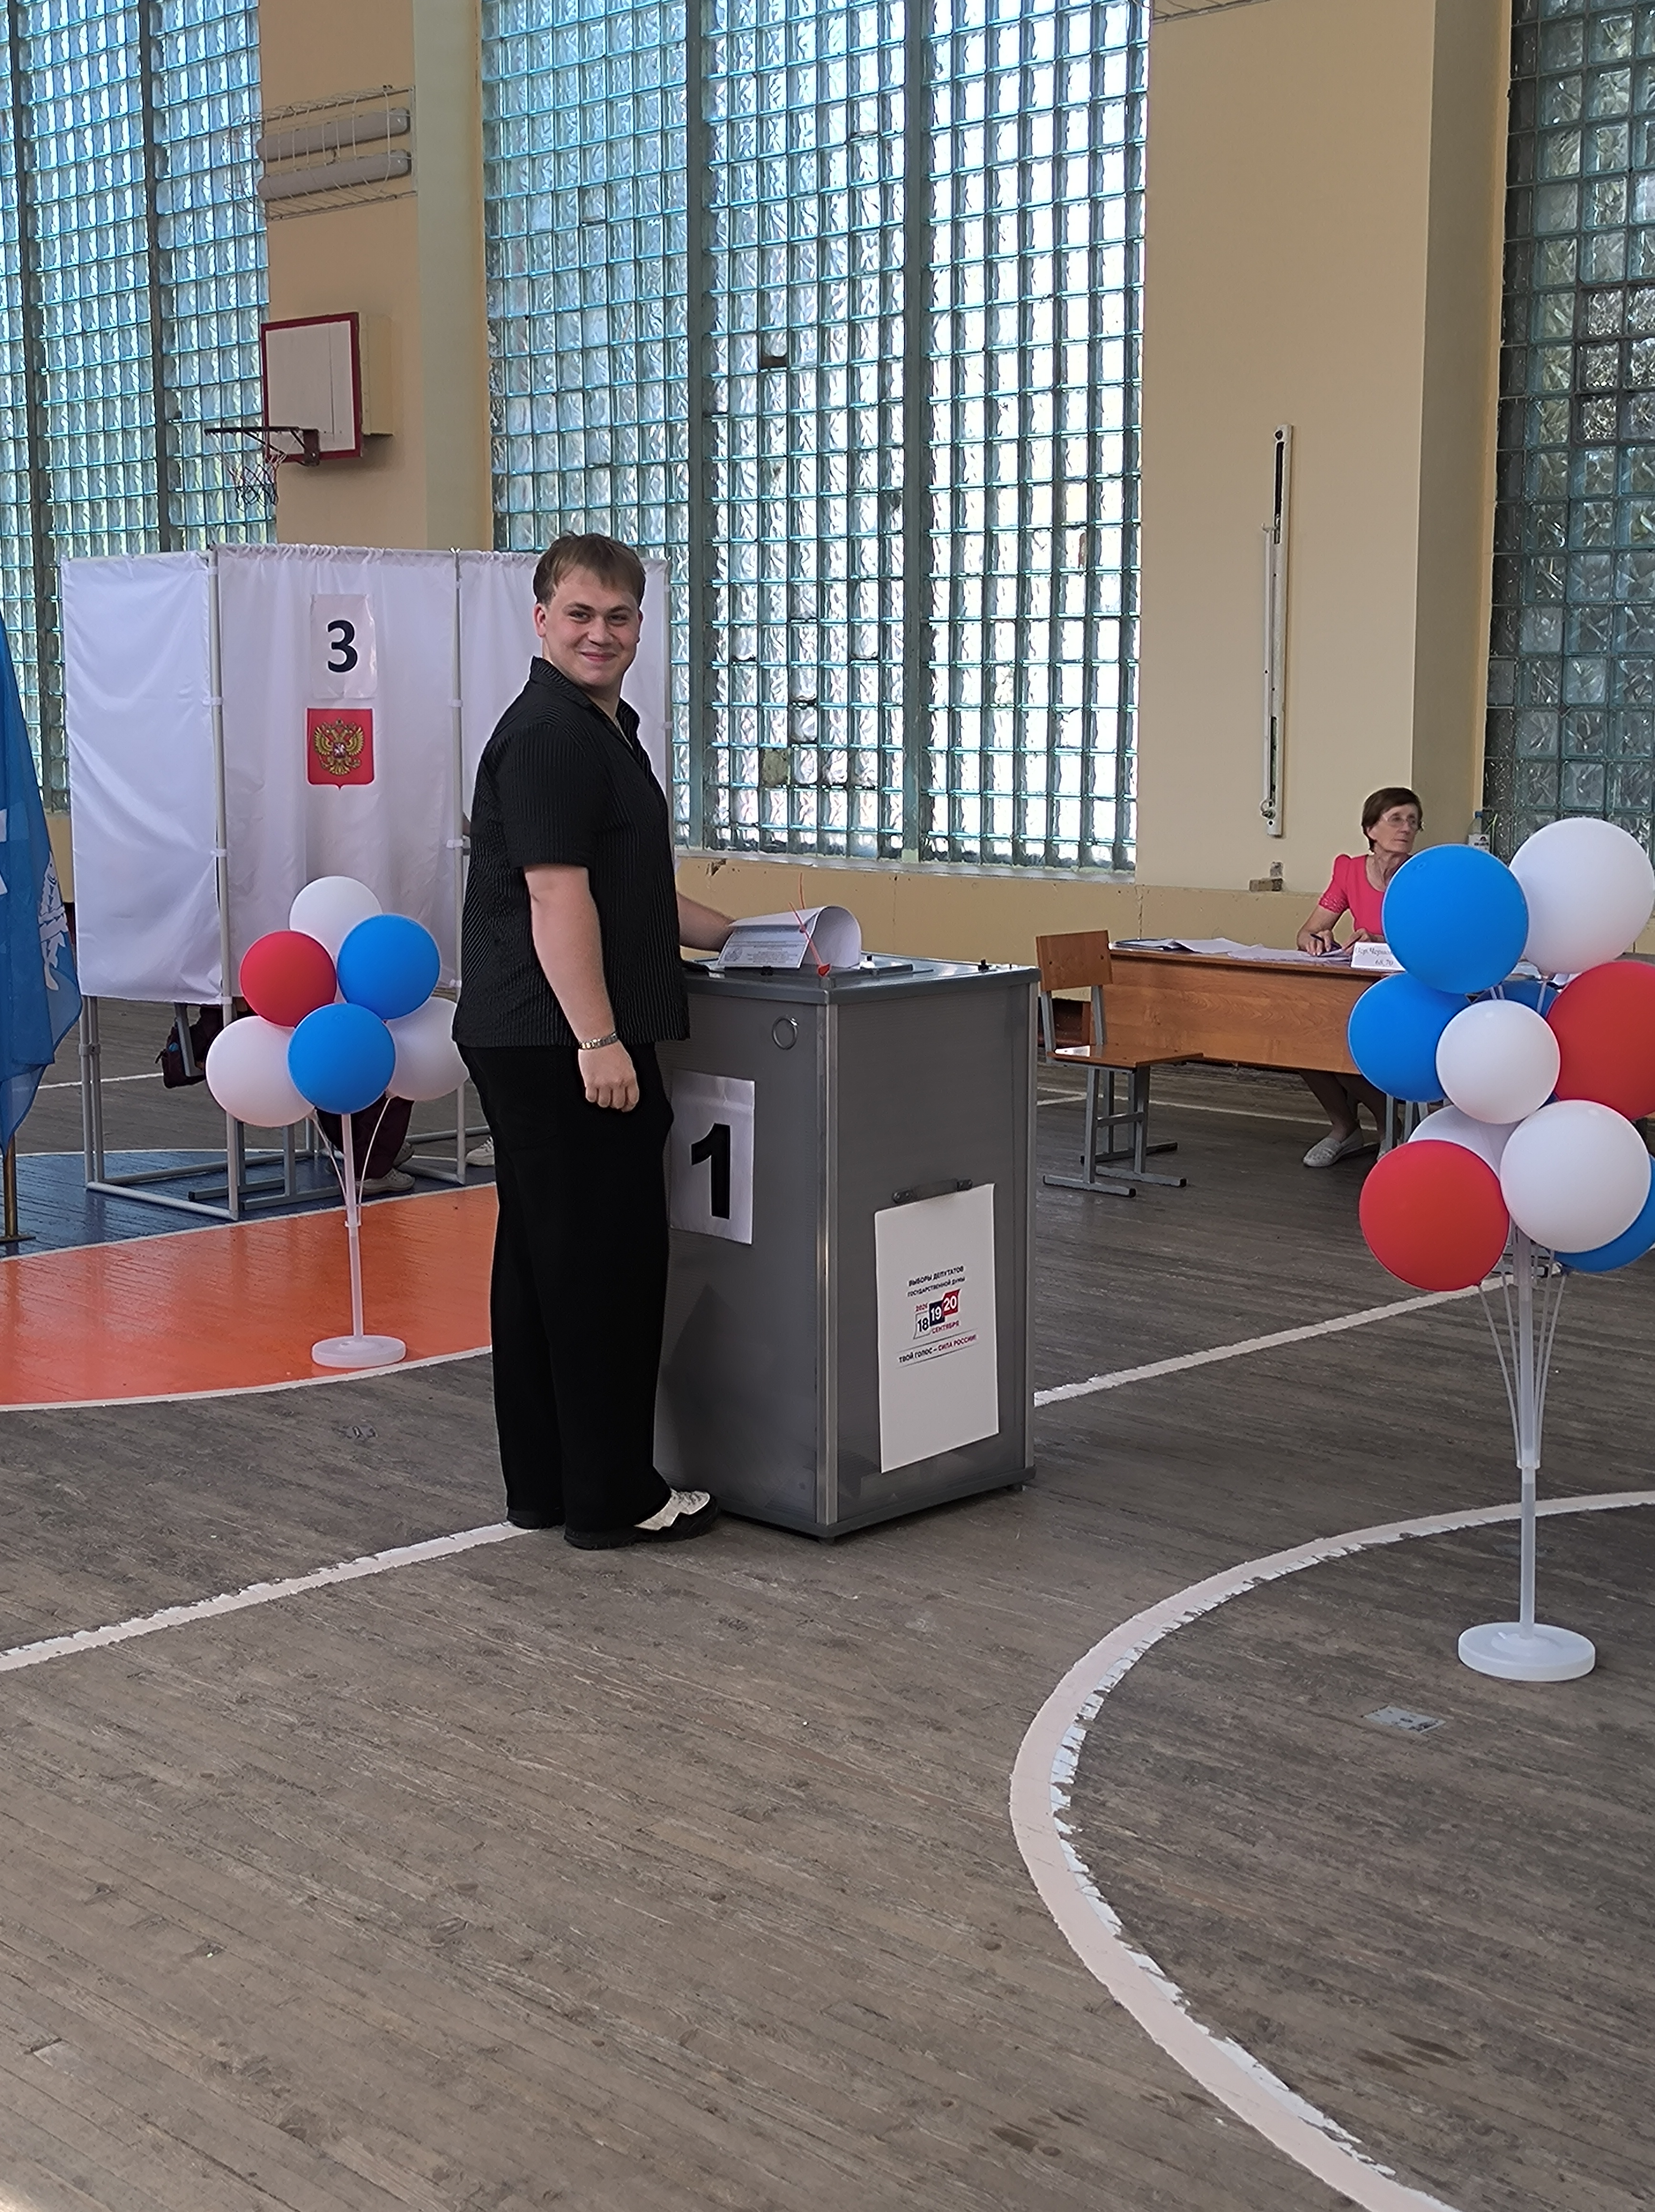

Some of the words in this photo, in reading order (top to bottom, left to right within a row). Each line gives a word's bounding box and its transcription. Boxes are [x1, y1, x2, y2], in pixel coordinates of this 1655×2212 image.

[327, 620, 358, 672] 3
[692, 1123, 730, 1219] 1
[908, 1279, 951, 1297] ГОСУДАРСТВЕННОЙ
[952, 1276, 965, 1285] ДУМЫ
[909, 1274, 932, 1286] ВЫБОРЫ
[933, 1266, 964, 1280] ДЕПУТАТОВ
[918, 1318, 929, 1332] 18
[931, 1306, 941, 1321] 19
[943, 1295, 957, 1311] 20
[932, 1320, 960, 1334] СЕНТЯБРЯ
[899, 1352, 913, 1362] ТВОЙ
[915, 1347, 932, 1358] ГОЛОС
[938, 1342, 952, 1351] СИЛА
